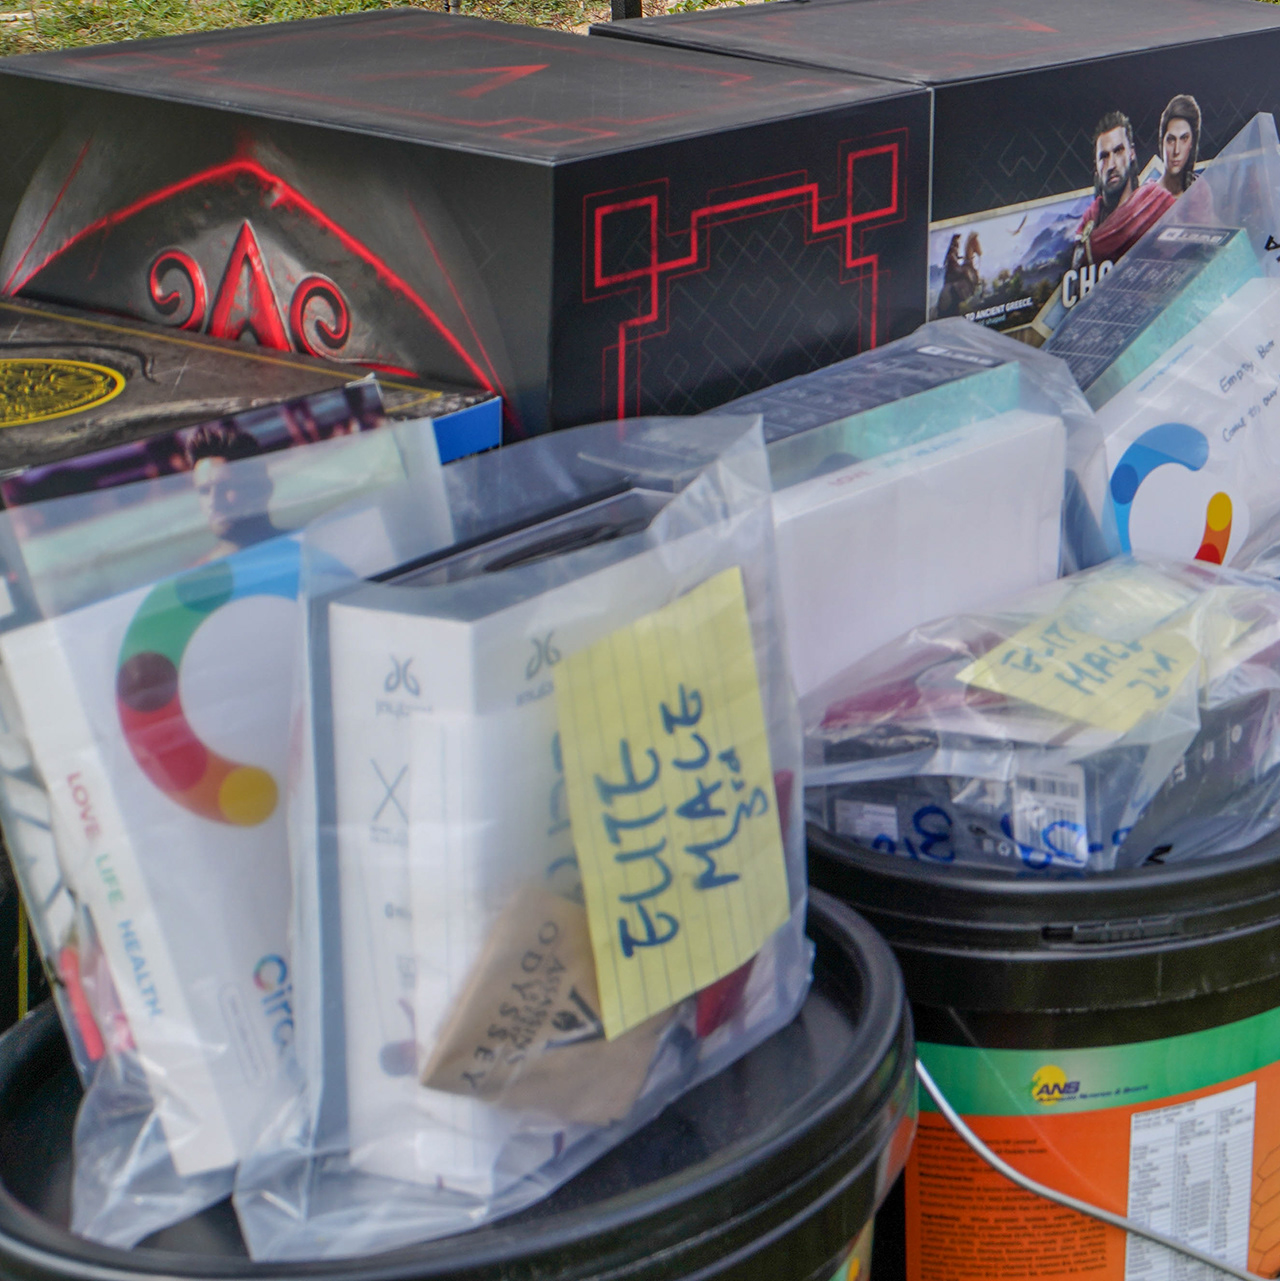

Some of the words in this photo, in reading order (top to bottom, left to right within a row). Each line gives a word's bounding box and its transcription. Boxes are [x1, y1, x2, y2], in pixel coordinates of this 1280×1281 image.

[975, 304, 1005, 318] ANCIENT
[67, 771, 102, 840] LOVE
[659, 683, 741, 891] MALE
[96, 853, 124, 905] LIFE
[594, 738, 680, 958] ELITE
[118, 919, 164, 1018] HEALTH
[461, 921, 559, 1090] ODYSSEY
[1036, 1080, 1081, 1096] ANS
